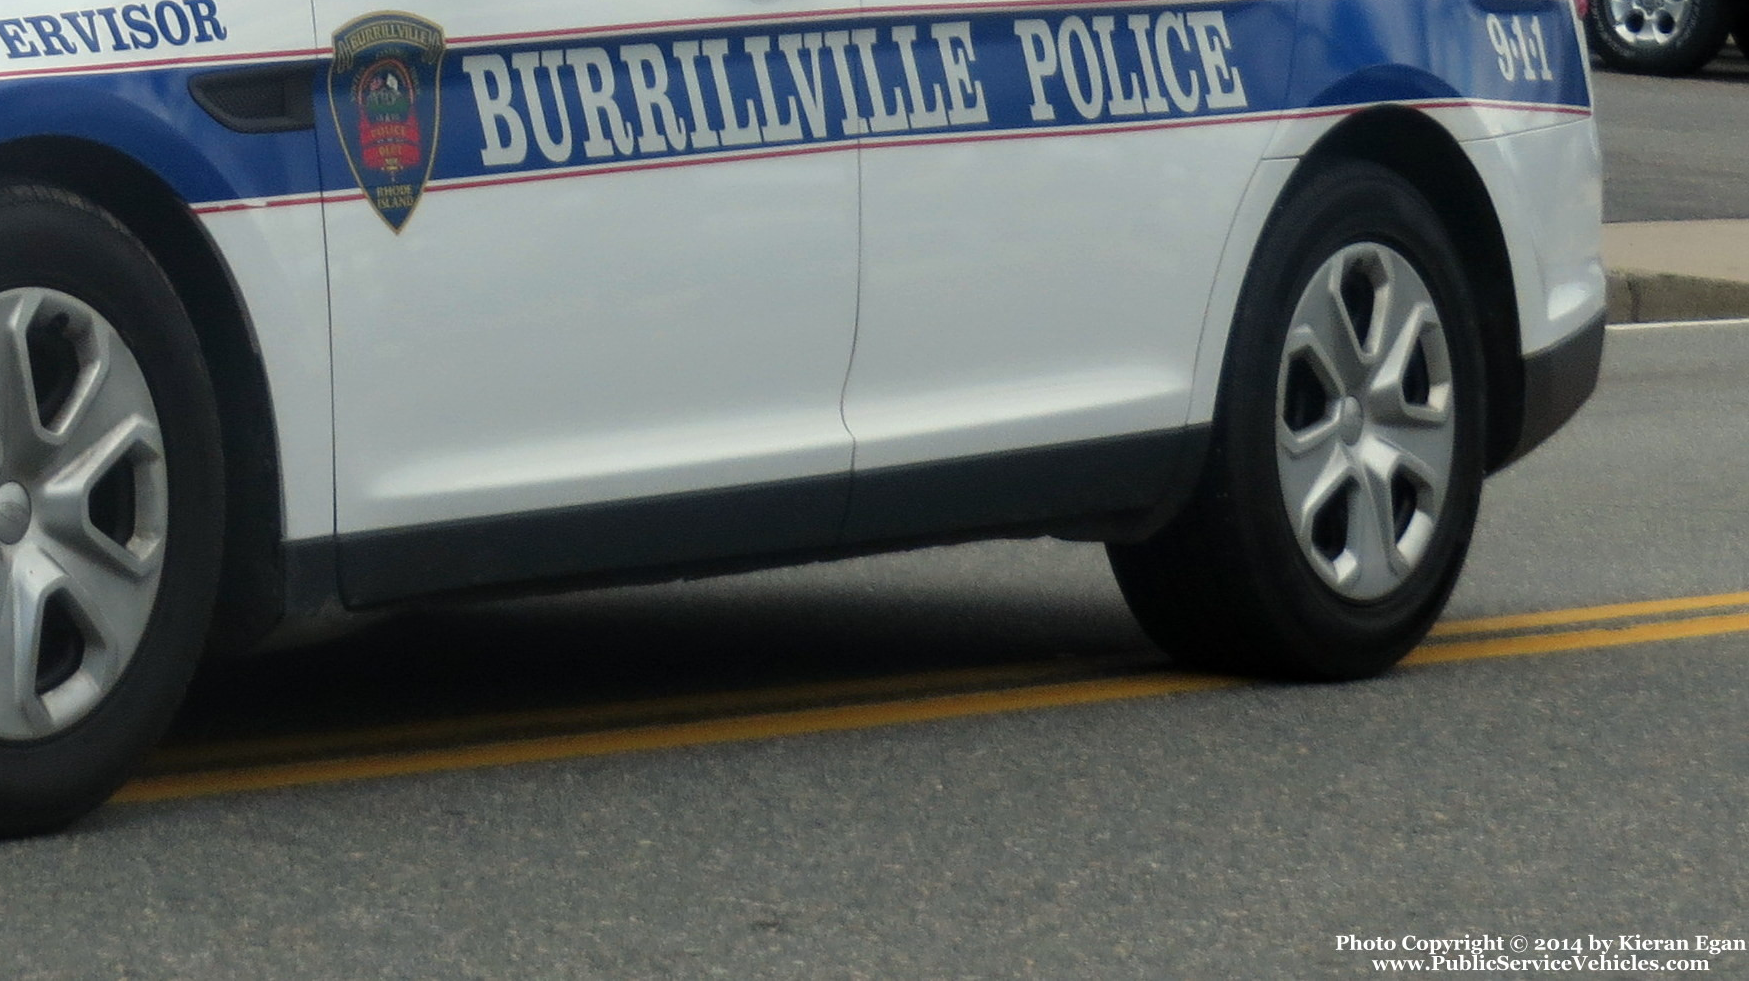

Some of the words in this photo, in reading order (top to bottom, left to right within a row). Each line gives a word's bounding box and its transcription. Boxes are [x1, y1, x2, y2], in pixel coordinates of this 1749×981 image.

[351, 23, 429, 49] BURRILLVILLE
[462, 20, 989, 167] BURRILLVILLE
[1013, 10, 1248, 121] POLICE
[376, 184, 413, 197] RHODE
[377, 196, 414, 209] ISLAND
